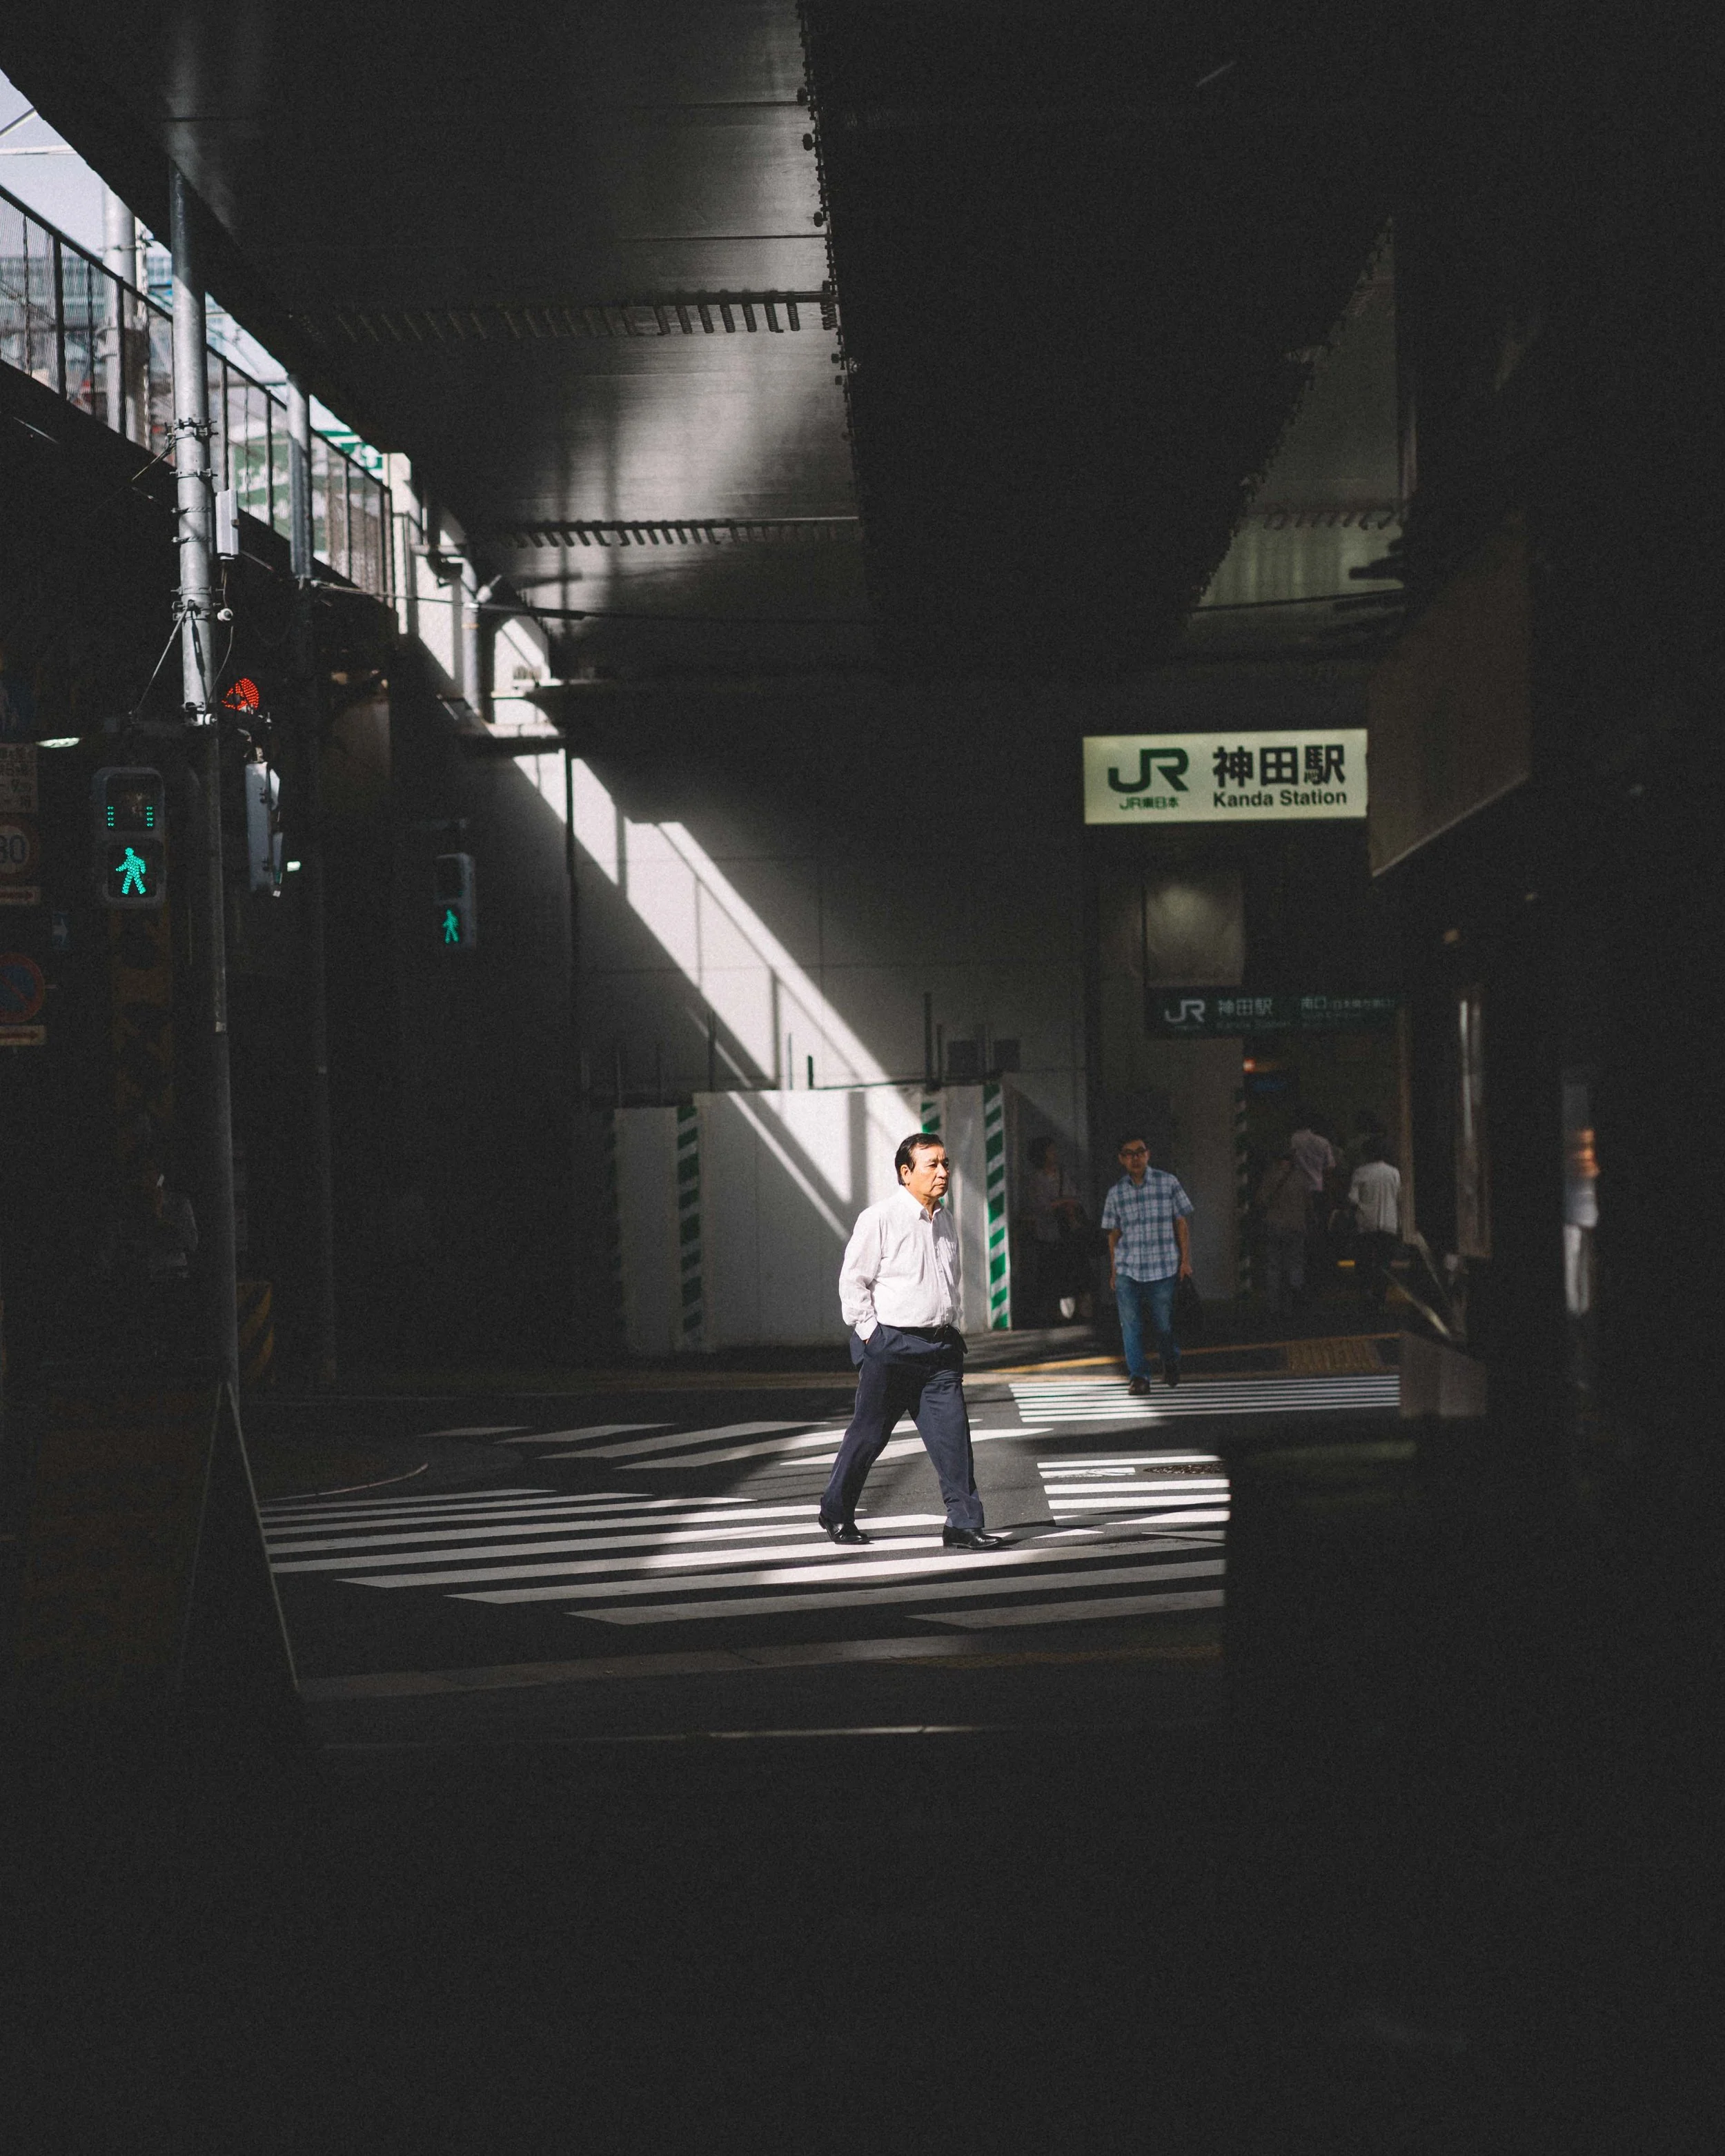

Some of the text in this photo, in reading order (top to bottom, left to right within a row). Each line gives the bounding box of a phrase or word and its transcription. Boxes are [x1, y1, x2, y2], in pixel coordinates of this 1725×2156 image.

[1107, 748, 1190, 795] JR
[1212, 744, 1346, 789] 神田駅
[1118, 796, 1179, 811] JR東日本
[1213, 788, 1348, 809] Kanda Station
[1164, 999, 1206, 1024] JR
[1218, 997, 1273, 1017] 神田駅
